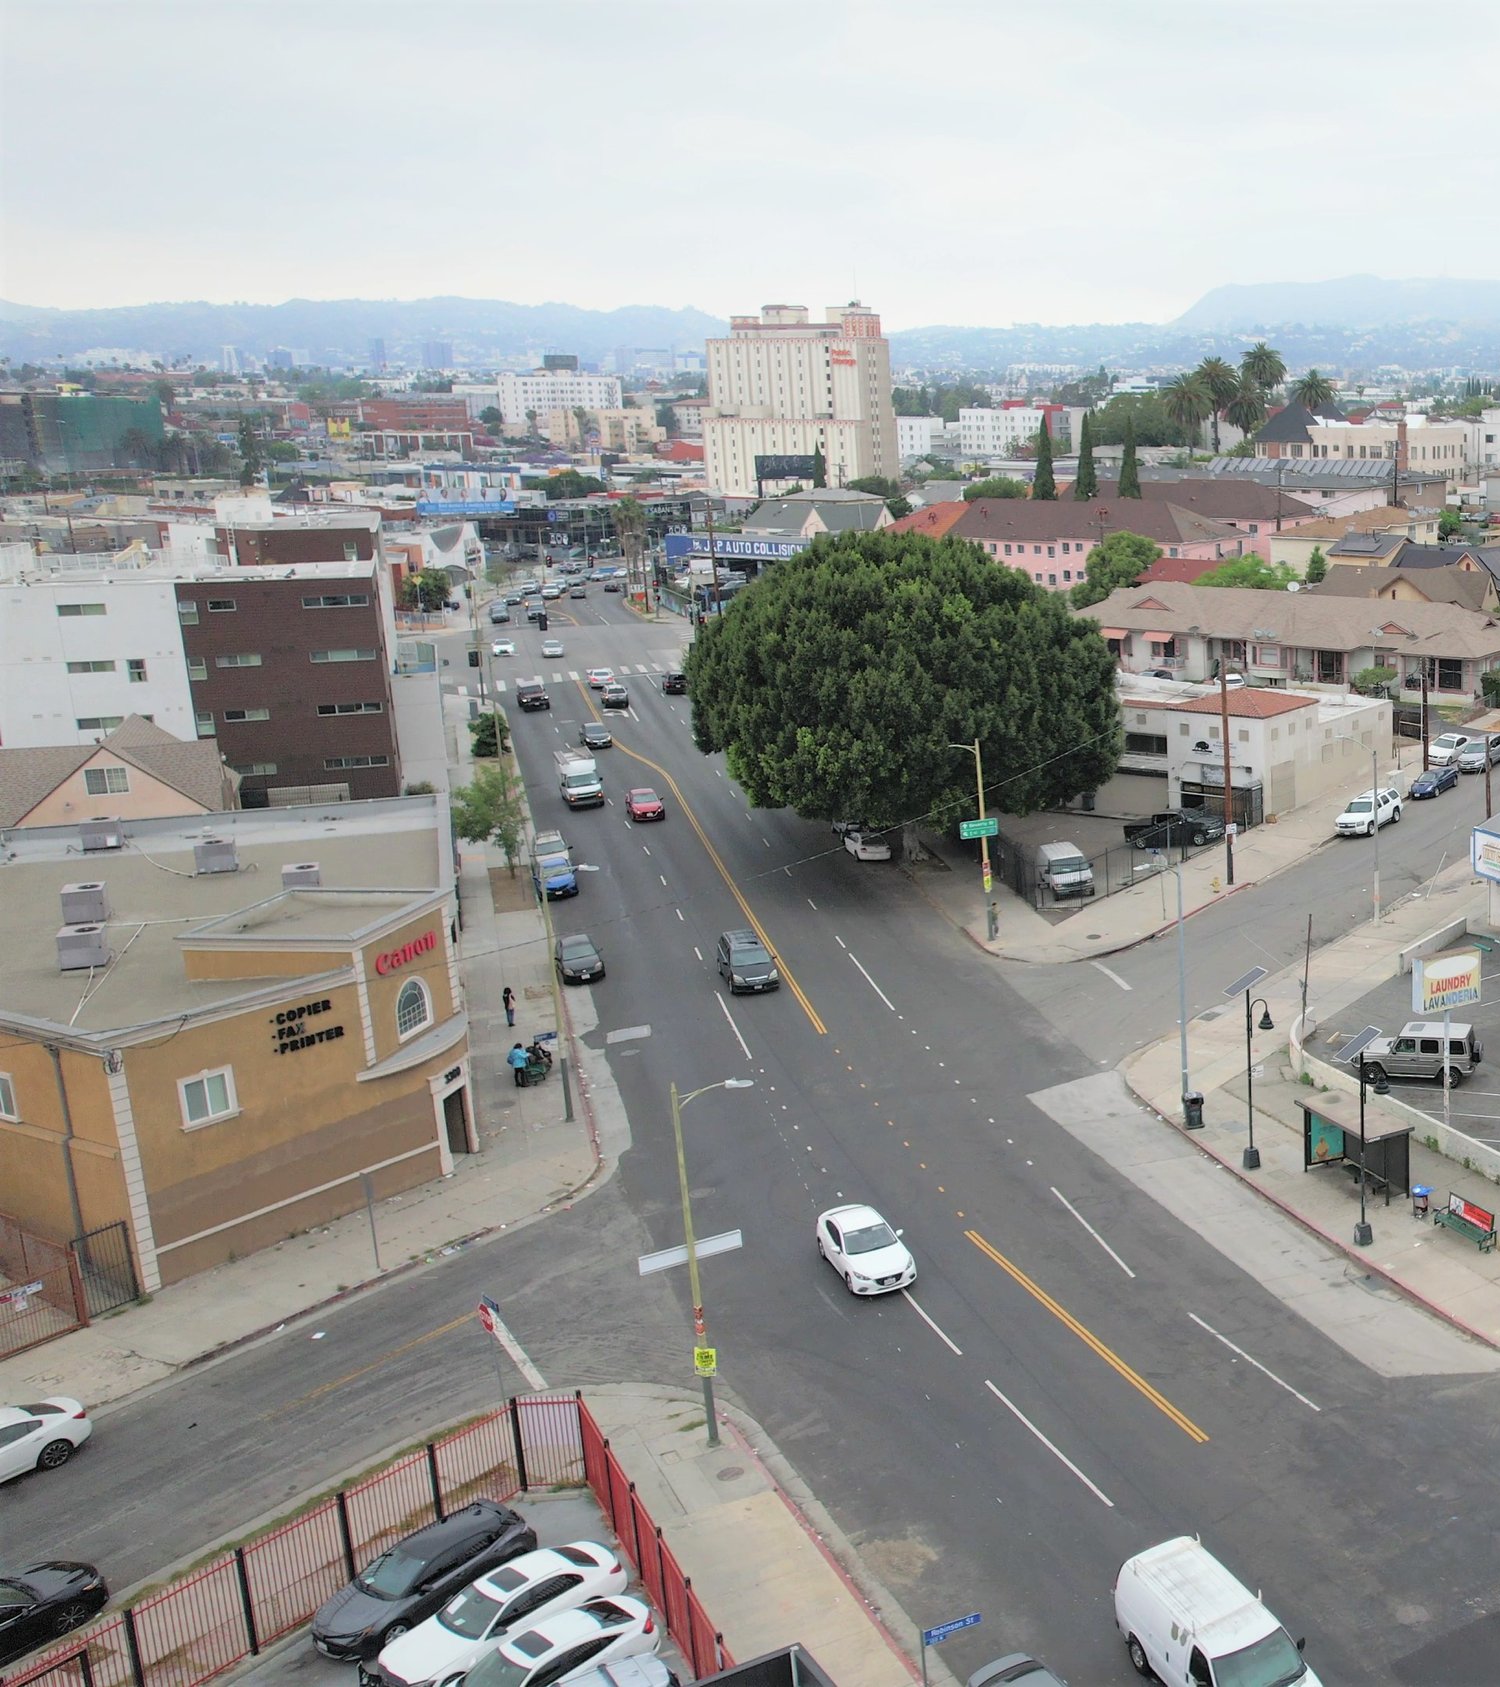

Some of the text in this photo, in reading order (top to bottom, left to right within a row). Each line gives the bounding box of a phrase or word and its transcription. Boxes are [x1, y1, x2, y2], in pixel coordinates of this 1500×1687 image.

[726, 541, 752, 554] AUTO
[754, 542, 803, 558] COLLISION
[375, 930, 437, 975] Canon
[1430, 973, 1472, 995] LAUNDRY
[1423, 987, 1479, 1011] LAVANDERIA
[275, 999, 332, 1025] COPIER
[277, 1021, 305, 1041] FAX
[279, 1025, 345, 1054] PRINTER
[931, 1617, 974, 1637] Robinson St
